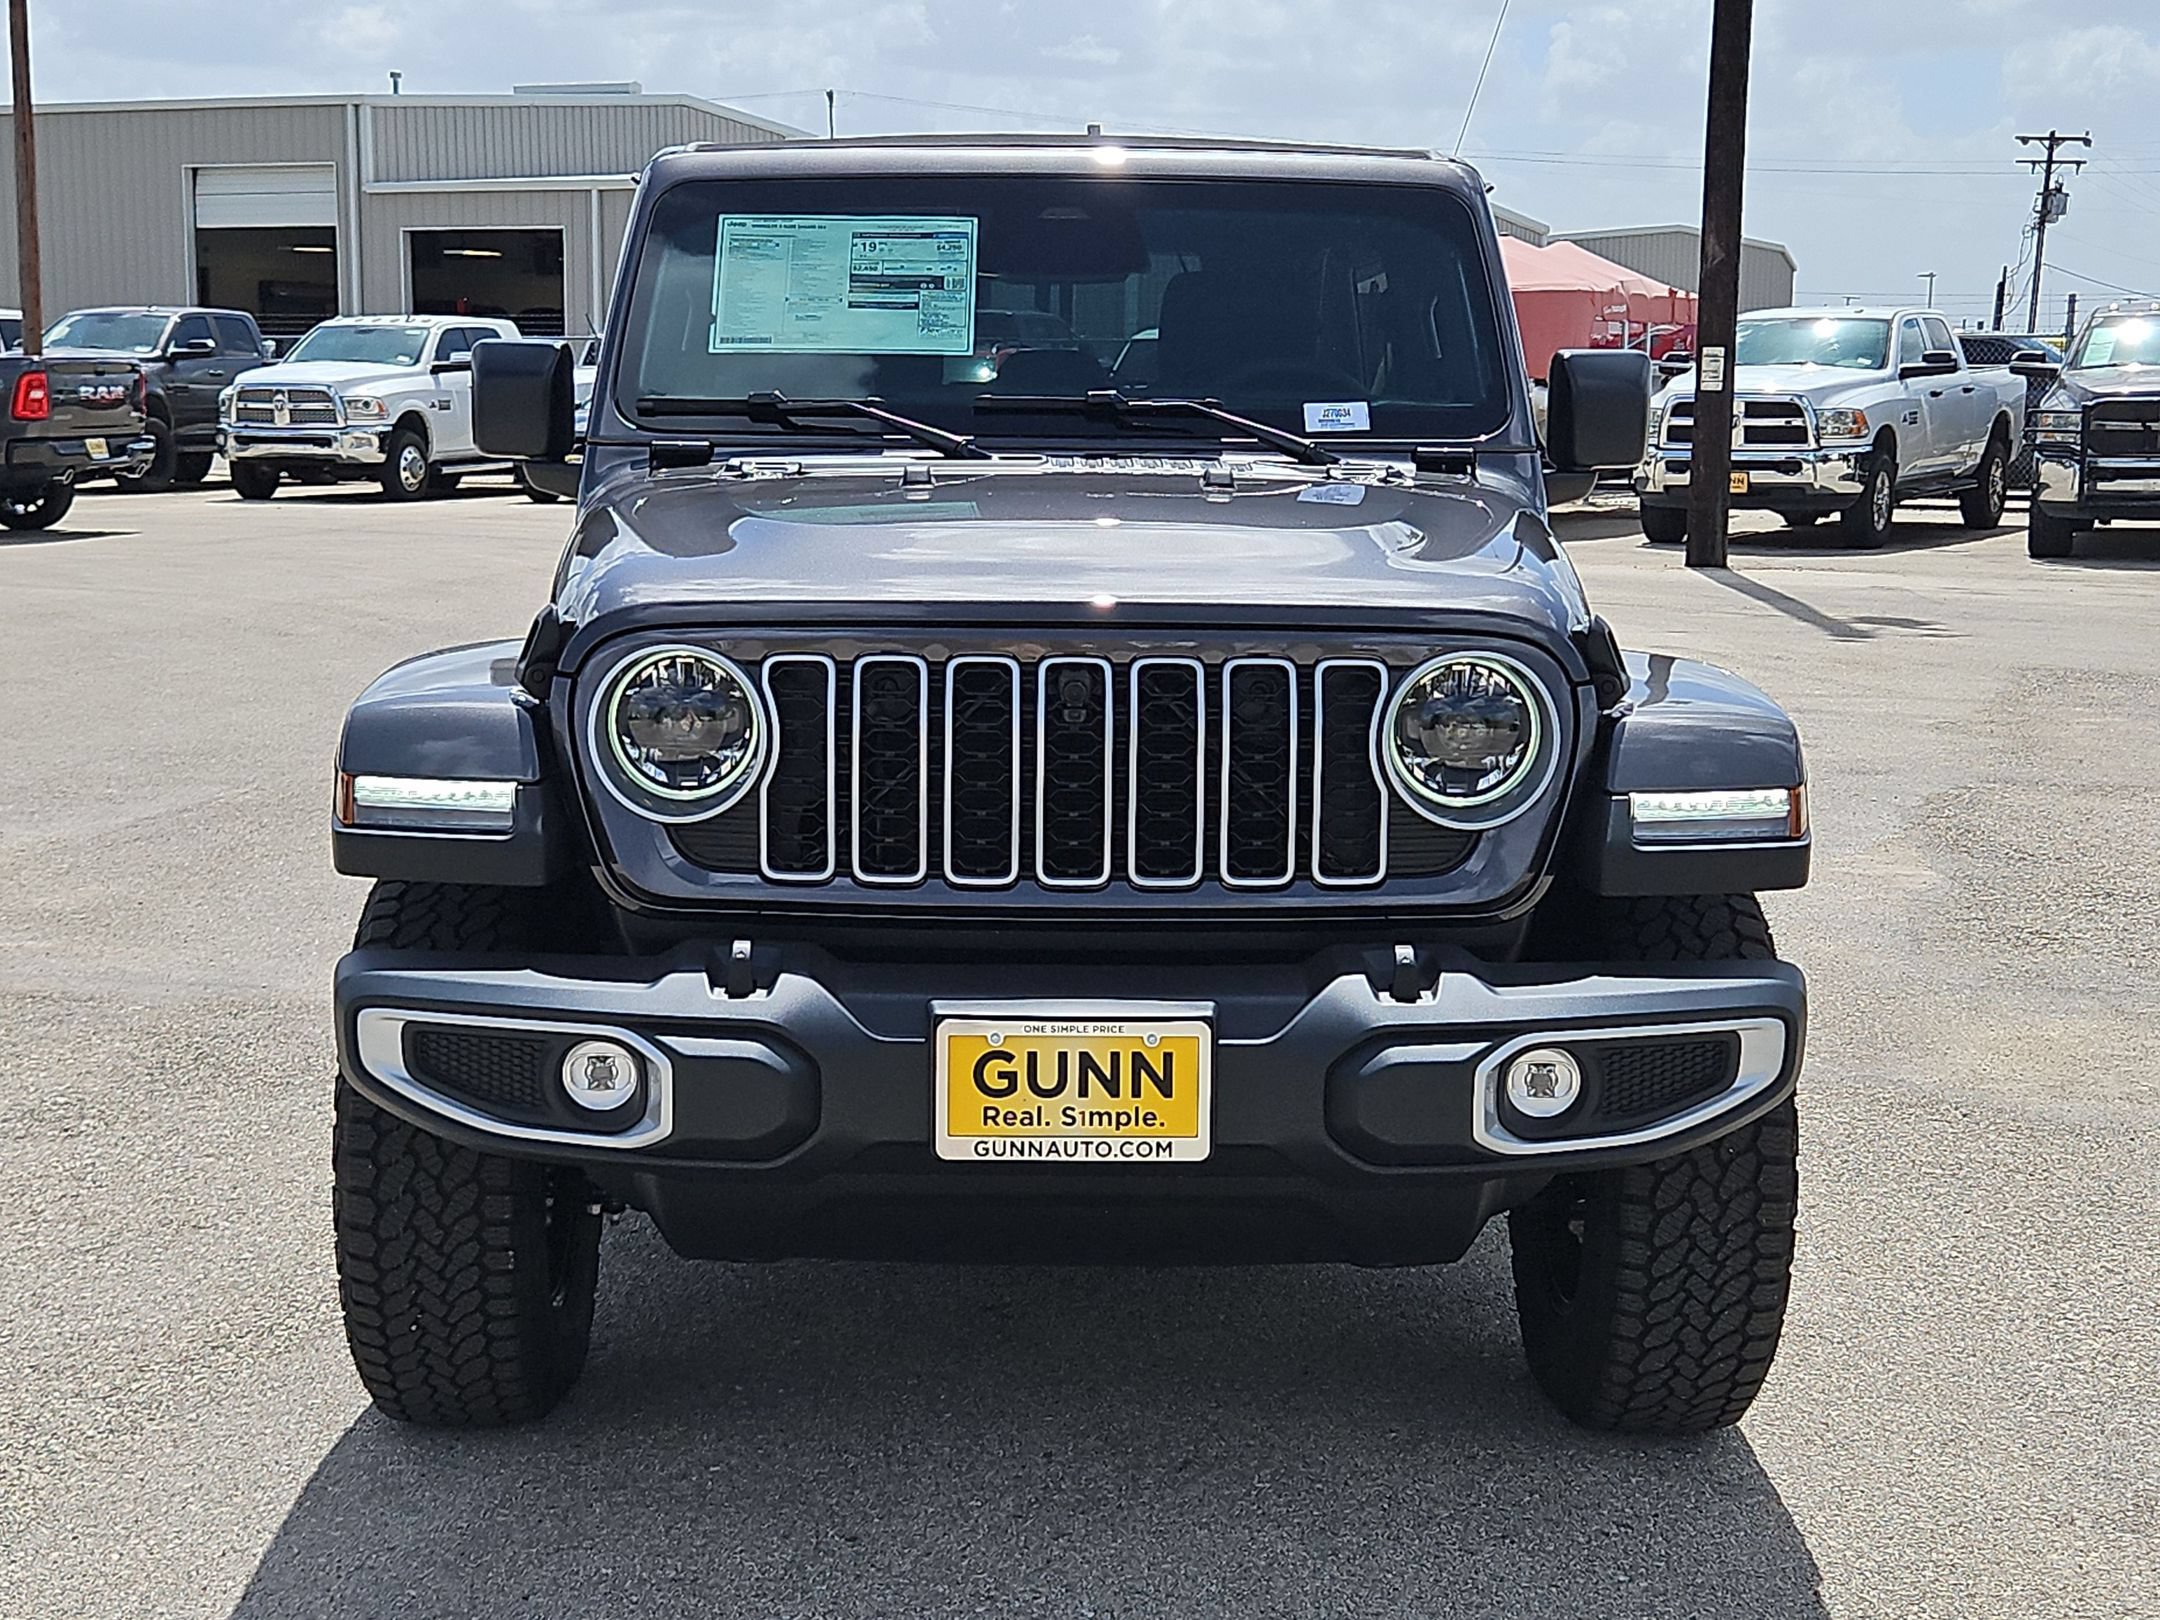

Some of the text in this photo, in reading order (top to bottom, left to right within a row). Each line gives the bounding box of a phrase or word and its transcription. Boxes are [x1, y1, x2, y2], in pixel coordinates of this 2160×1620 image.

[861, 242, 877, 252] 19
[79, 385, 126, 401] RAM
[1023, 1025, 1125, 1034] ONE SIMPLE PRICE
[972, 1049, 1174, 1099] GUNN
[982, 1106, 1051, 1127] Real.
[973, 1140, 1174, 1158] GUNNAUTO.COM
